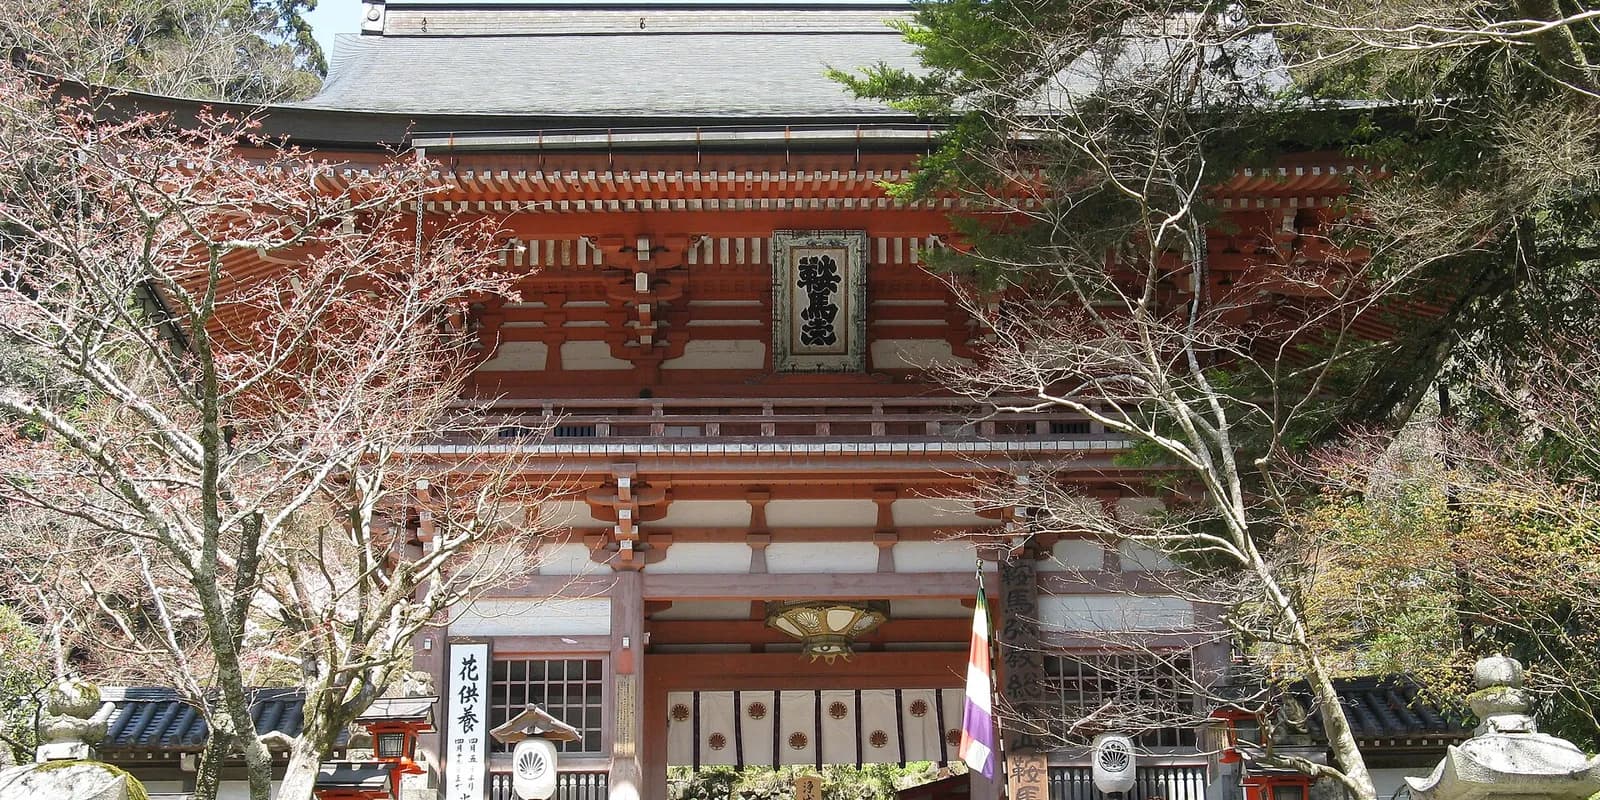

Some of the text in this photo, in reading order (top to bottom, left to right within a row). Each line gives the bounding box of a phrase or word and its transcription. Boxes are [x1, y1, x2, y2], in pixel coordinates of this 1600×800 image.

[457, 653, 480, 734] 花供養
[467, 737, 479, 791] 四月五より
